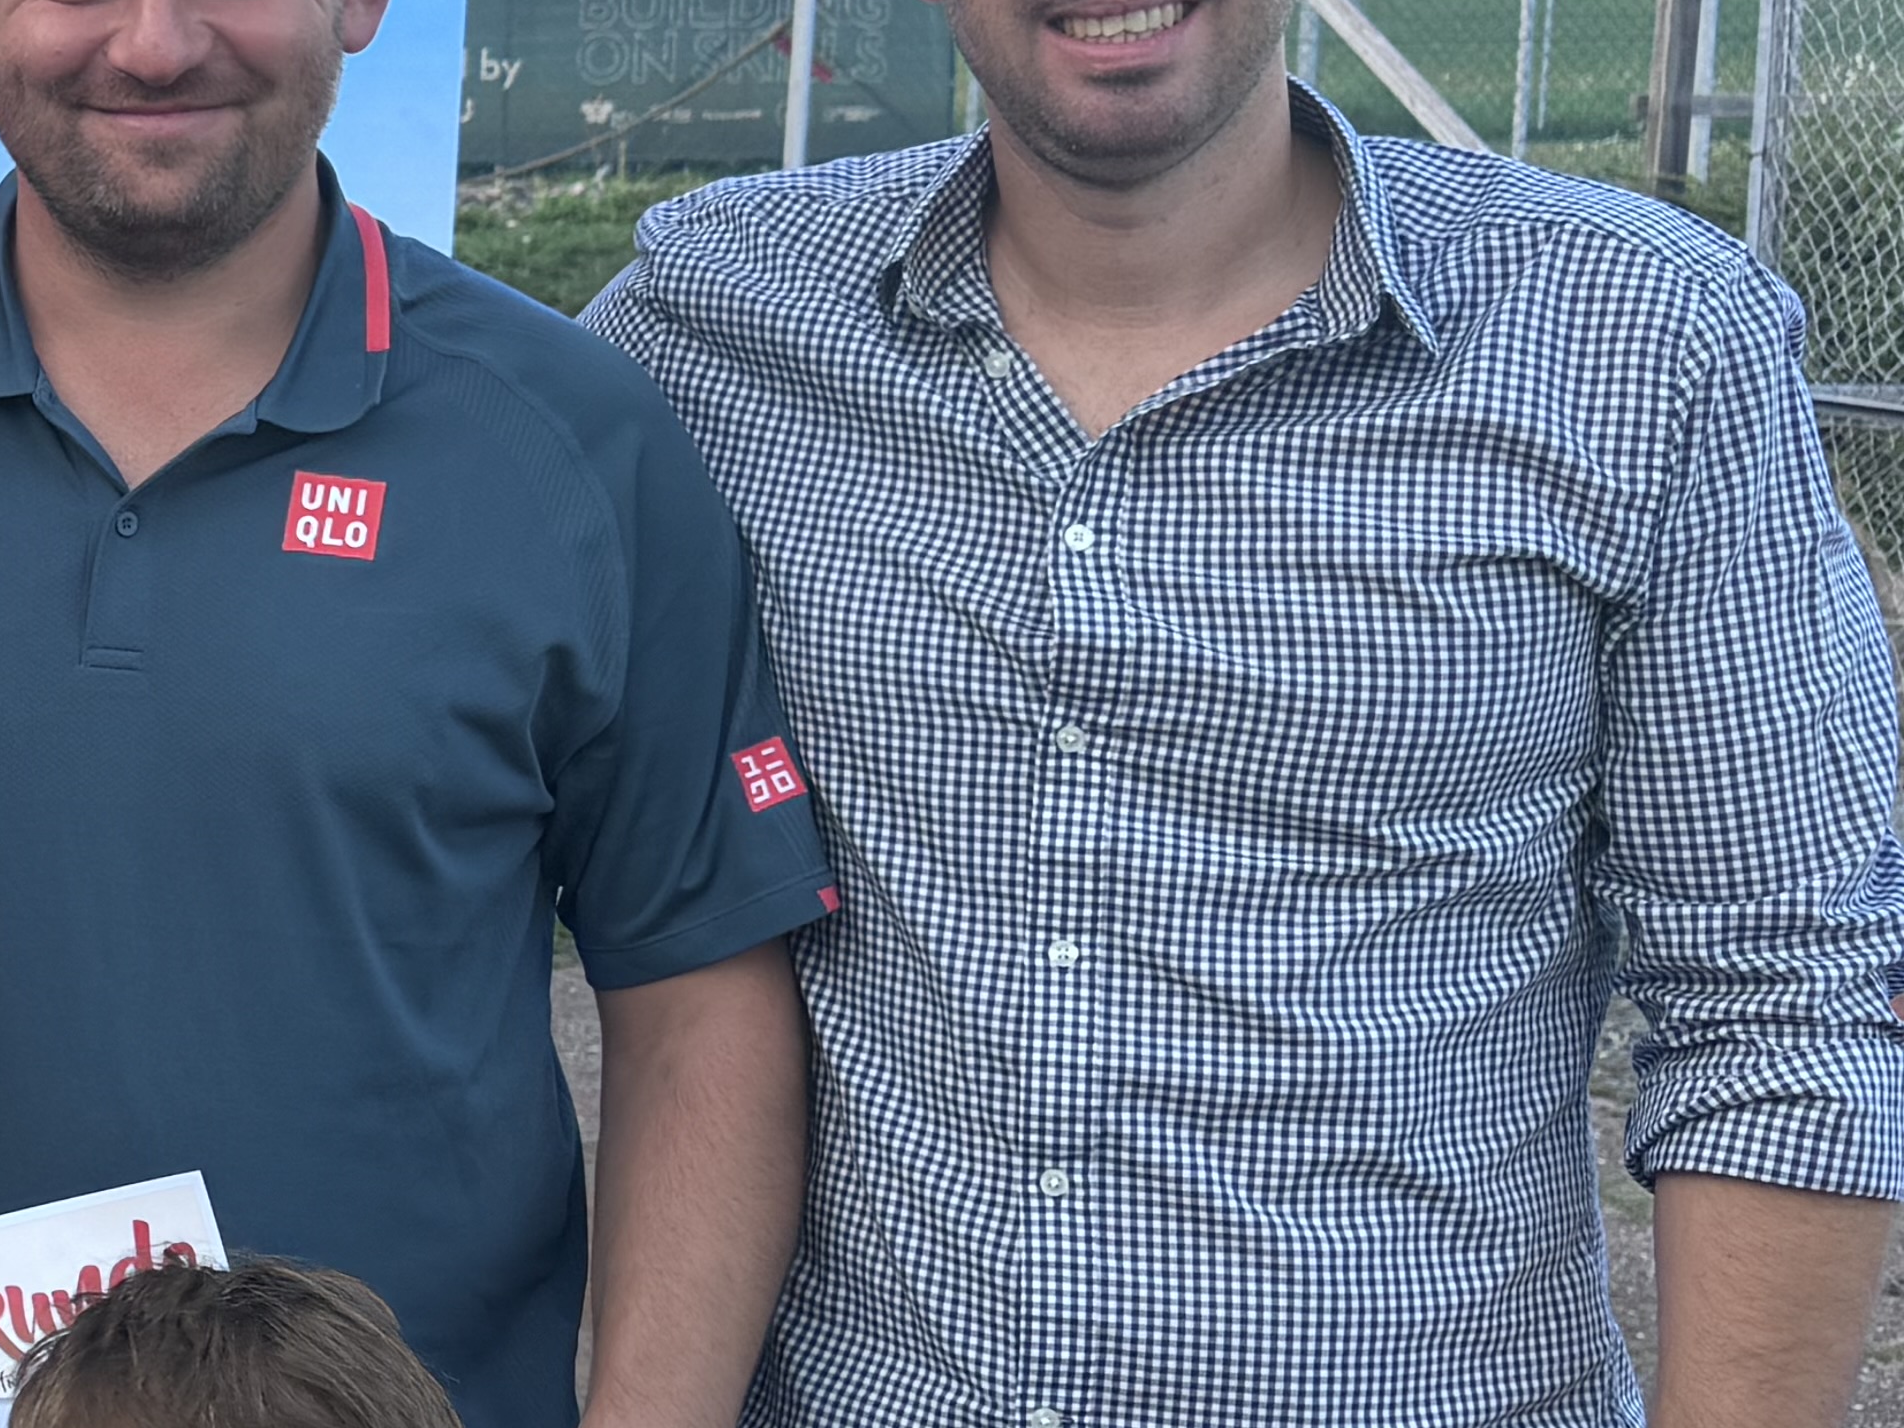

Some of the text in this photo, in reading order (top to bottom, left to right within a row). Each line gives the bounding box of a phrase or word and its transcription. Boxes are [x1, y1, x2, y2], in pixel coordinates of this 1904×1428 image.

[480, 47, 523, 89] by
[577, 29, 678, 86] ON
[301, 482, 368, 516] UNI
[295, 515, 368, 548] QLO
